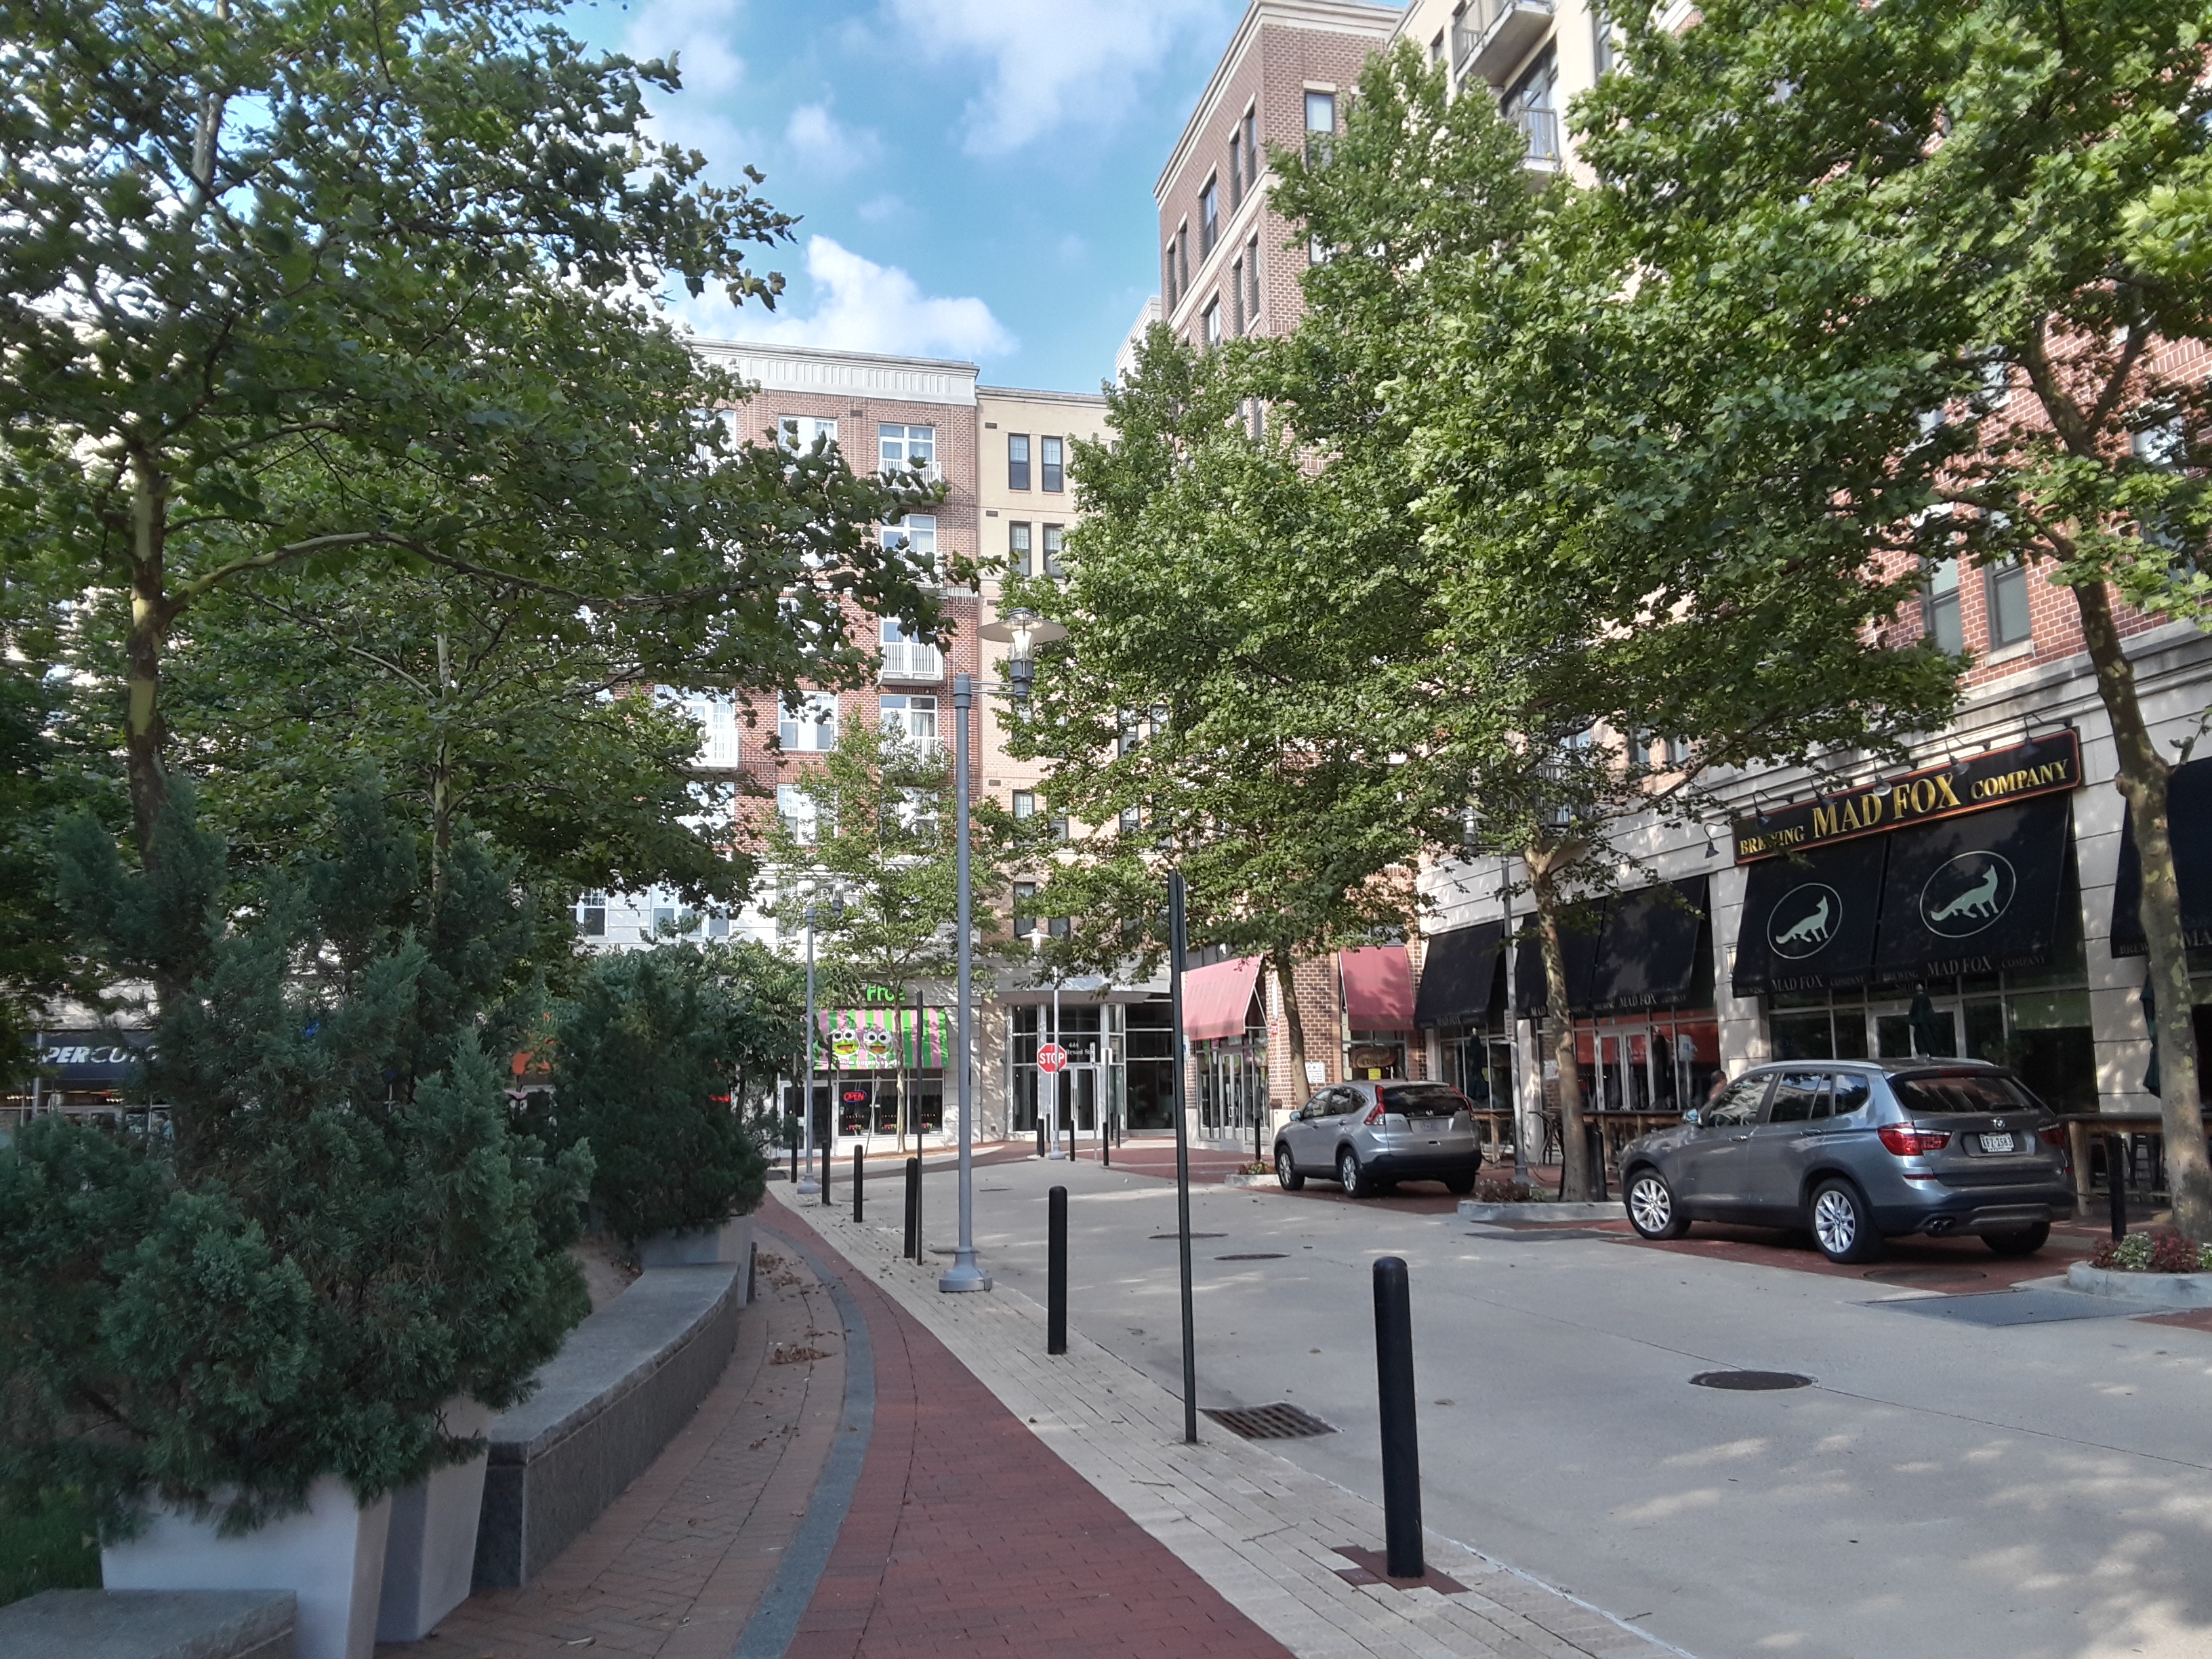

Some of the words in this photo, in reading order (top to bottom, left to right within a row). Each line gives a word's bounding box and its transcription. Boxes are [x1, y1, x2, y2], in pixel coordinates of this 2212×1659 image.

[1811, 793, 1883, 838] MAD
[1893, 772, 1961, 821] FOX
[1970, 758, 2069, 800] COMPANY
[1882, 968, 1919, 981] BREWING
[1927, 959, 1959, 976] MAD
[1963, 954, 1992, 973] FOX
[2002, 954, 2045, 969] COMPANY
[1771, 977, 1797, 992] MAD
[1799, 973, 1824, 989] FOX
[1619, 994, 1639, 1008] MAD
[1639, 991, 1658, 1006] FOX
[844, 1092, 865, 1101] OPEN
